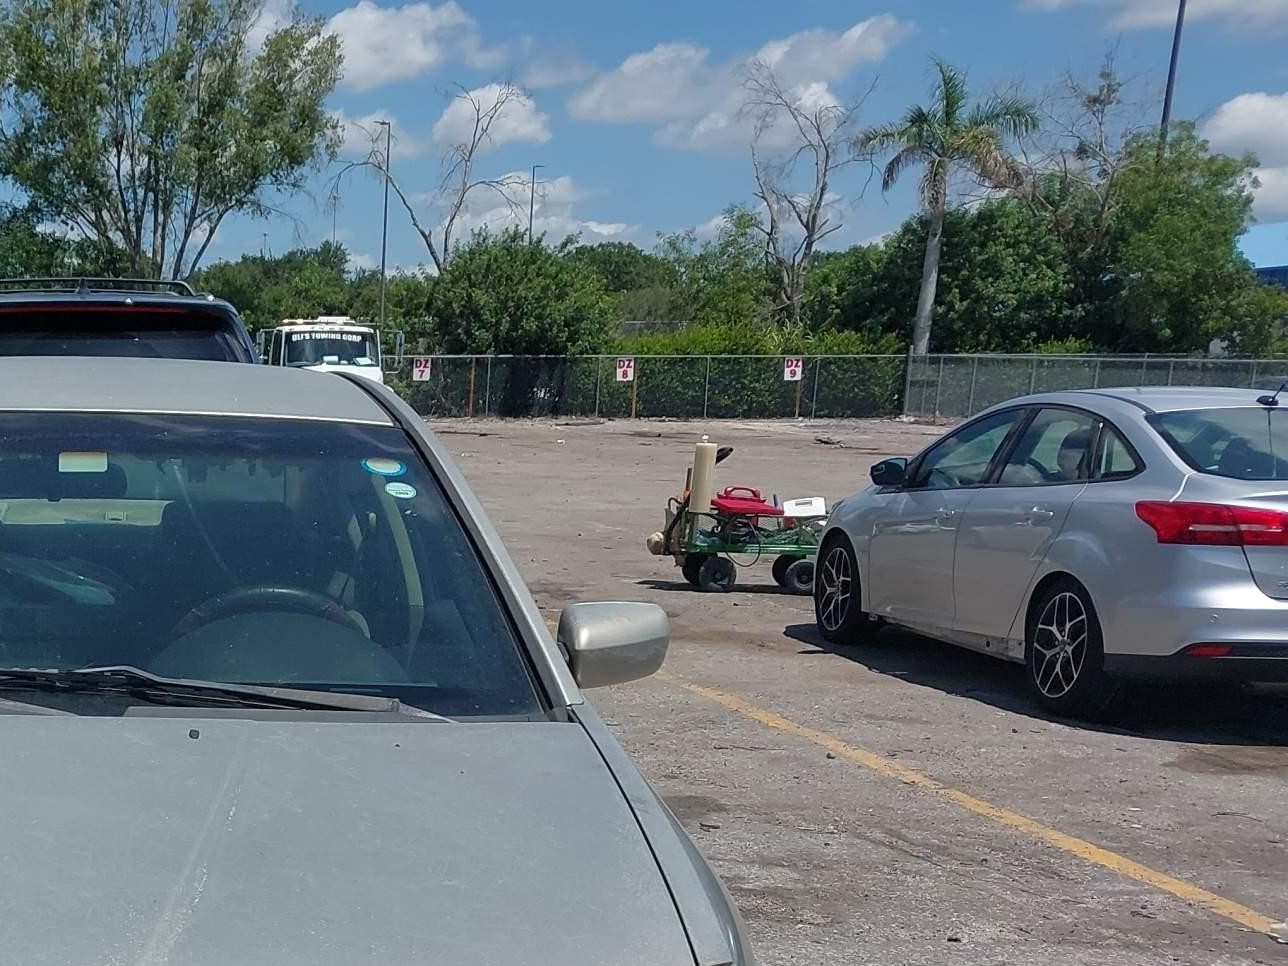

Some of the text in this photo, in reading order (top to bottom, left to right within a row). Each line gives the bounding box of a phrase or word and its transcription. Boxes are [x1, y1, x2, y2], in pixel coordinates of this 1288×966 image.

[311, 332, 341, 340] TOWING
[342, 333, 362, 343] CORP
[415, 359, 429, 369] DZ
[618, 359, 632, 369] DZ
[786, 359, 801, 369] DZ
[418, 370, 425, 379] 7
[622, 369, 628, 379] 8
[790, 369, 797, 379] 9
